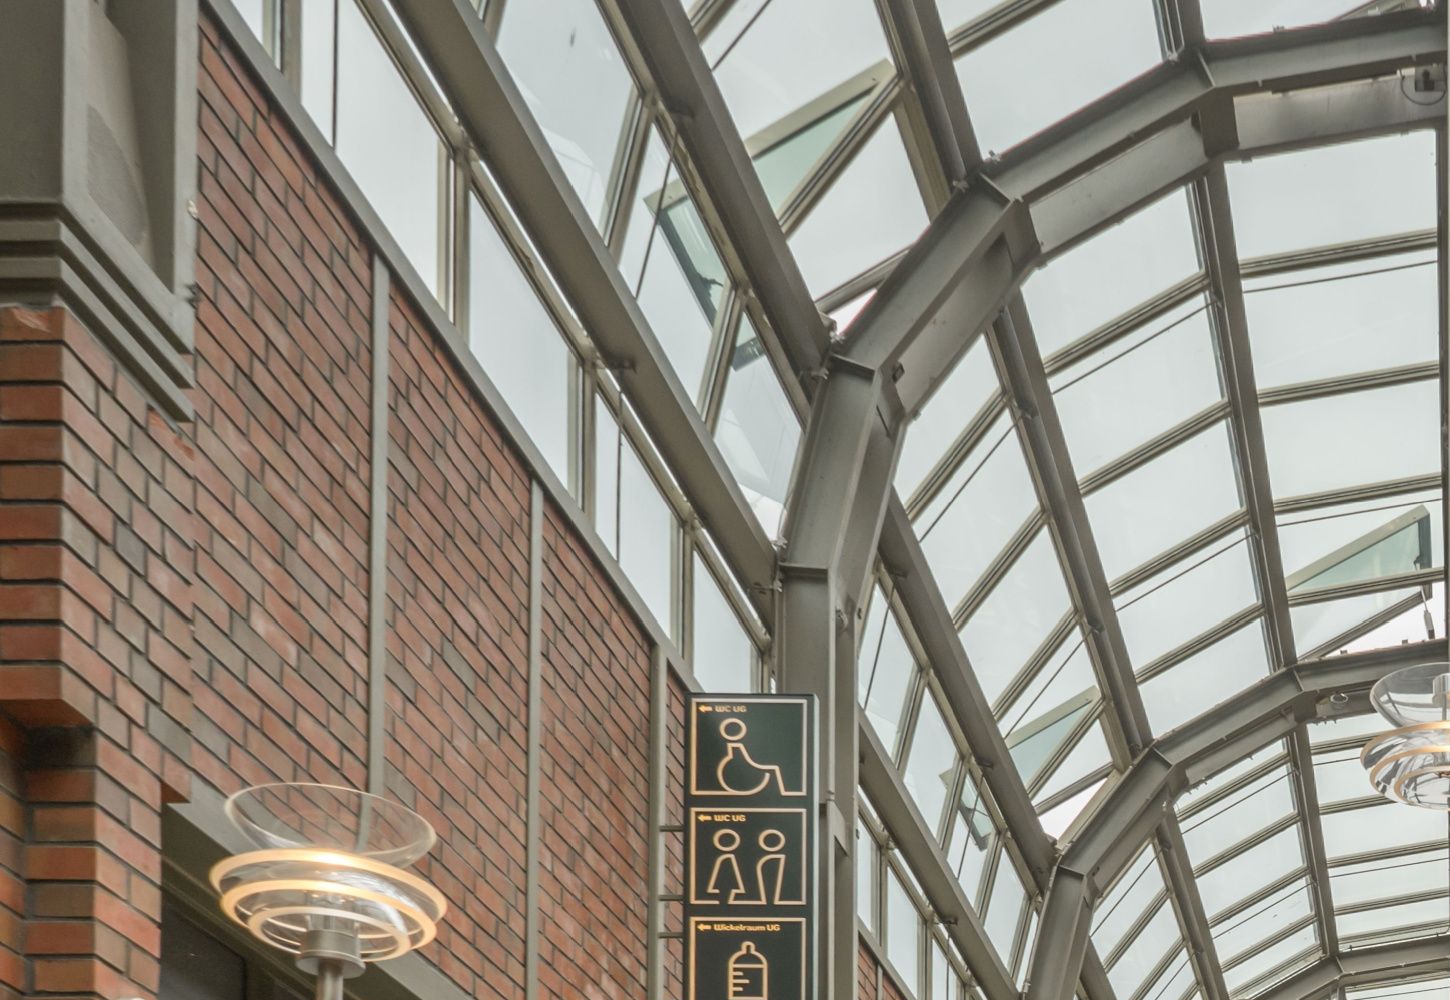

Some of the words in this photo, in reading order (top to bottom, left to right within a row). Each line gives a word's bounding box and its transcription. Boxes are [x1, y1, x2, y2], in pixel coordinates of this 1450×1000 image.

[715, 705, 731, 713] WC
[733, 705, 747, 713] UG
[714, 814, 731, 822] WC
[732, 814, 746, 822] UG
[713, 923, 766, 931] Wickelraum
